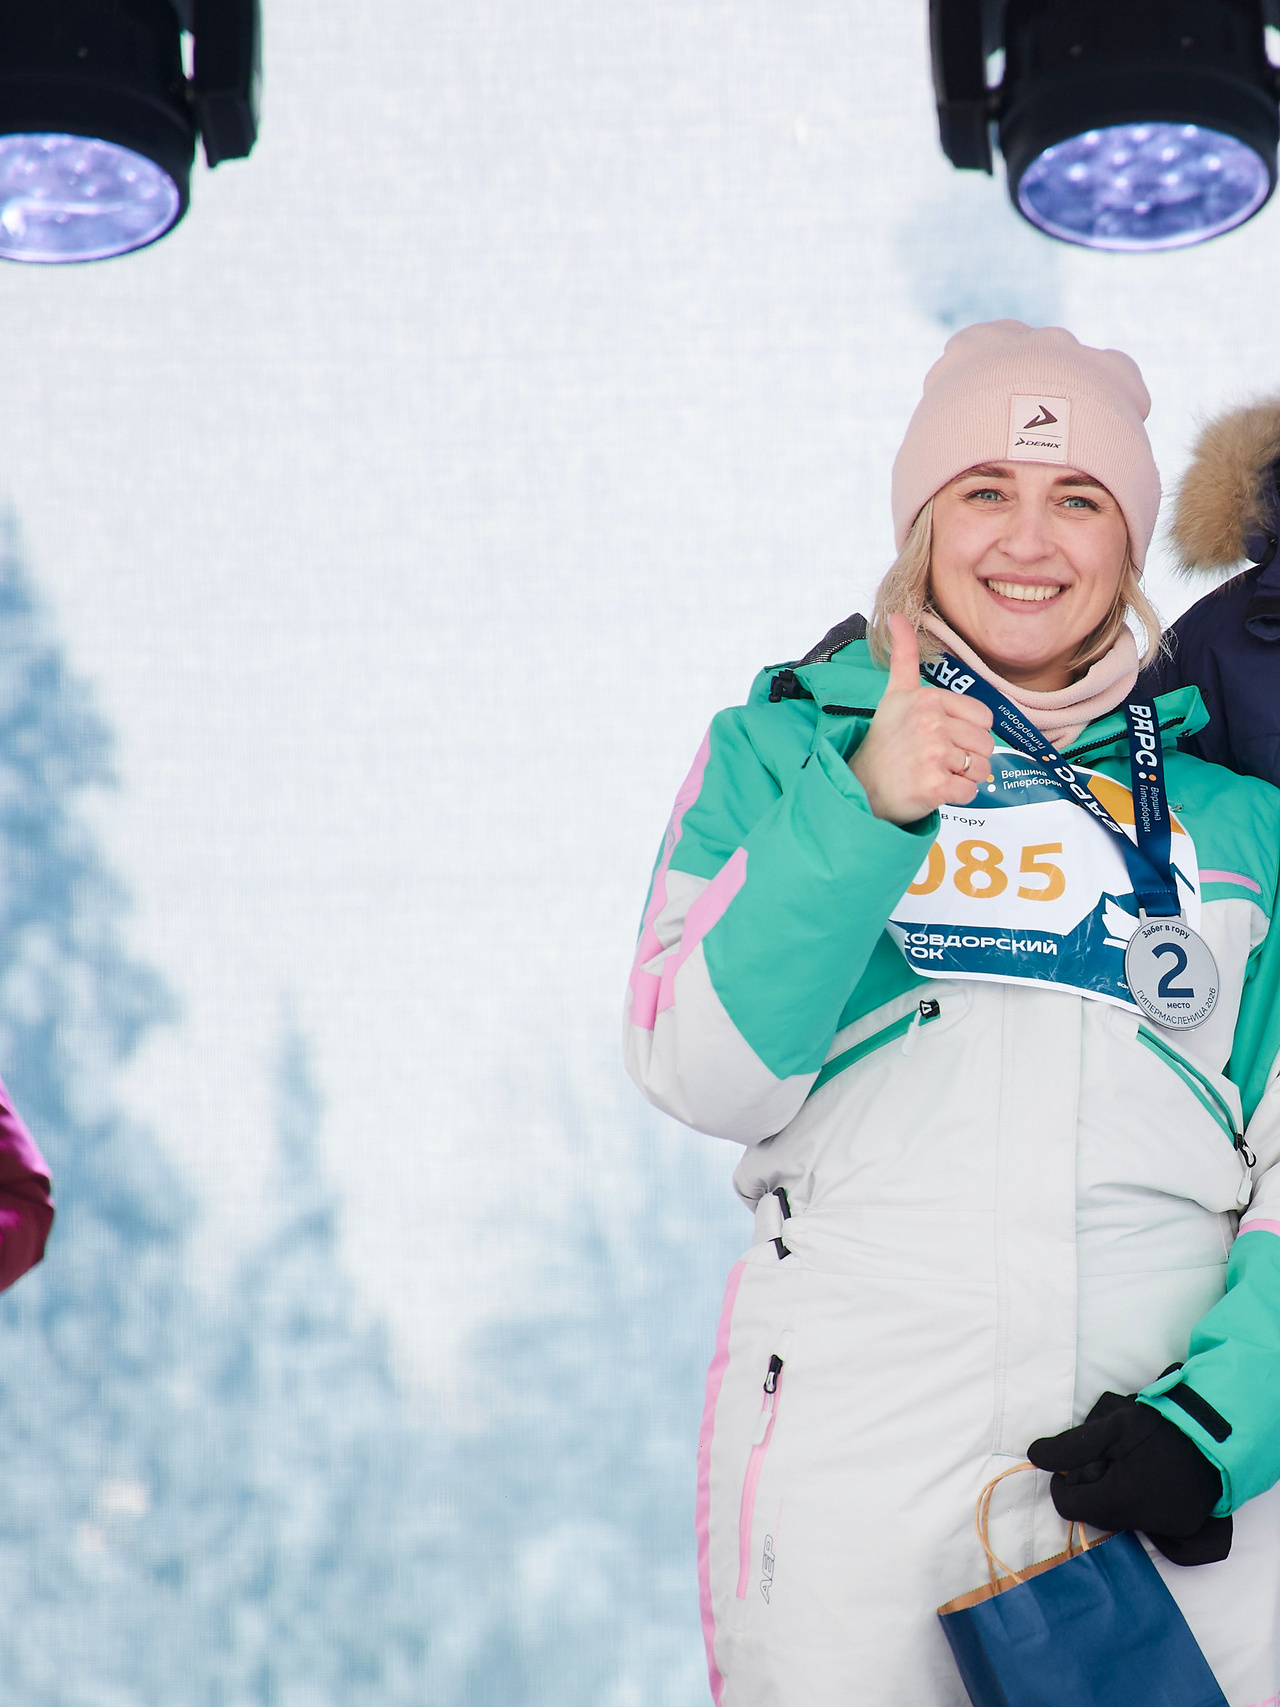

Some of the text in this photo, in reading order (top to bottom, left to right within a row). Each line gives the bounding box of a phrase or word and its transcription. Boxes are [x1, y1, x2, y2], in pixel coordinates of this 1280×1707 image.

[1025, 440, 1061, 449] DEMIX
[998, 704, 1046, 750] Гипербореи
[1000, 720, 1038, 752] Вершина
[1128, 704, 1158, 767] ВАРС
[1001, 769, 1048, 779] Вершина
[1003, 777, 1062, 790] Гипербореи
[1140, 784, 1151, 832] Гипербореи
[1150, 786, 1161, 821] Вершина
[953, 816, 986, 826] гору
[1142, 924, 1163, 938] Забег
[1171, 926, 1190, 939] гору
[1152, 942, 1194, 998] 2
[1137, 987, 1216, 1025] ГИПЕРМАСЛЕНИЦА 2026
